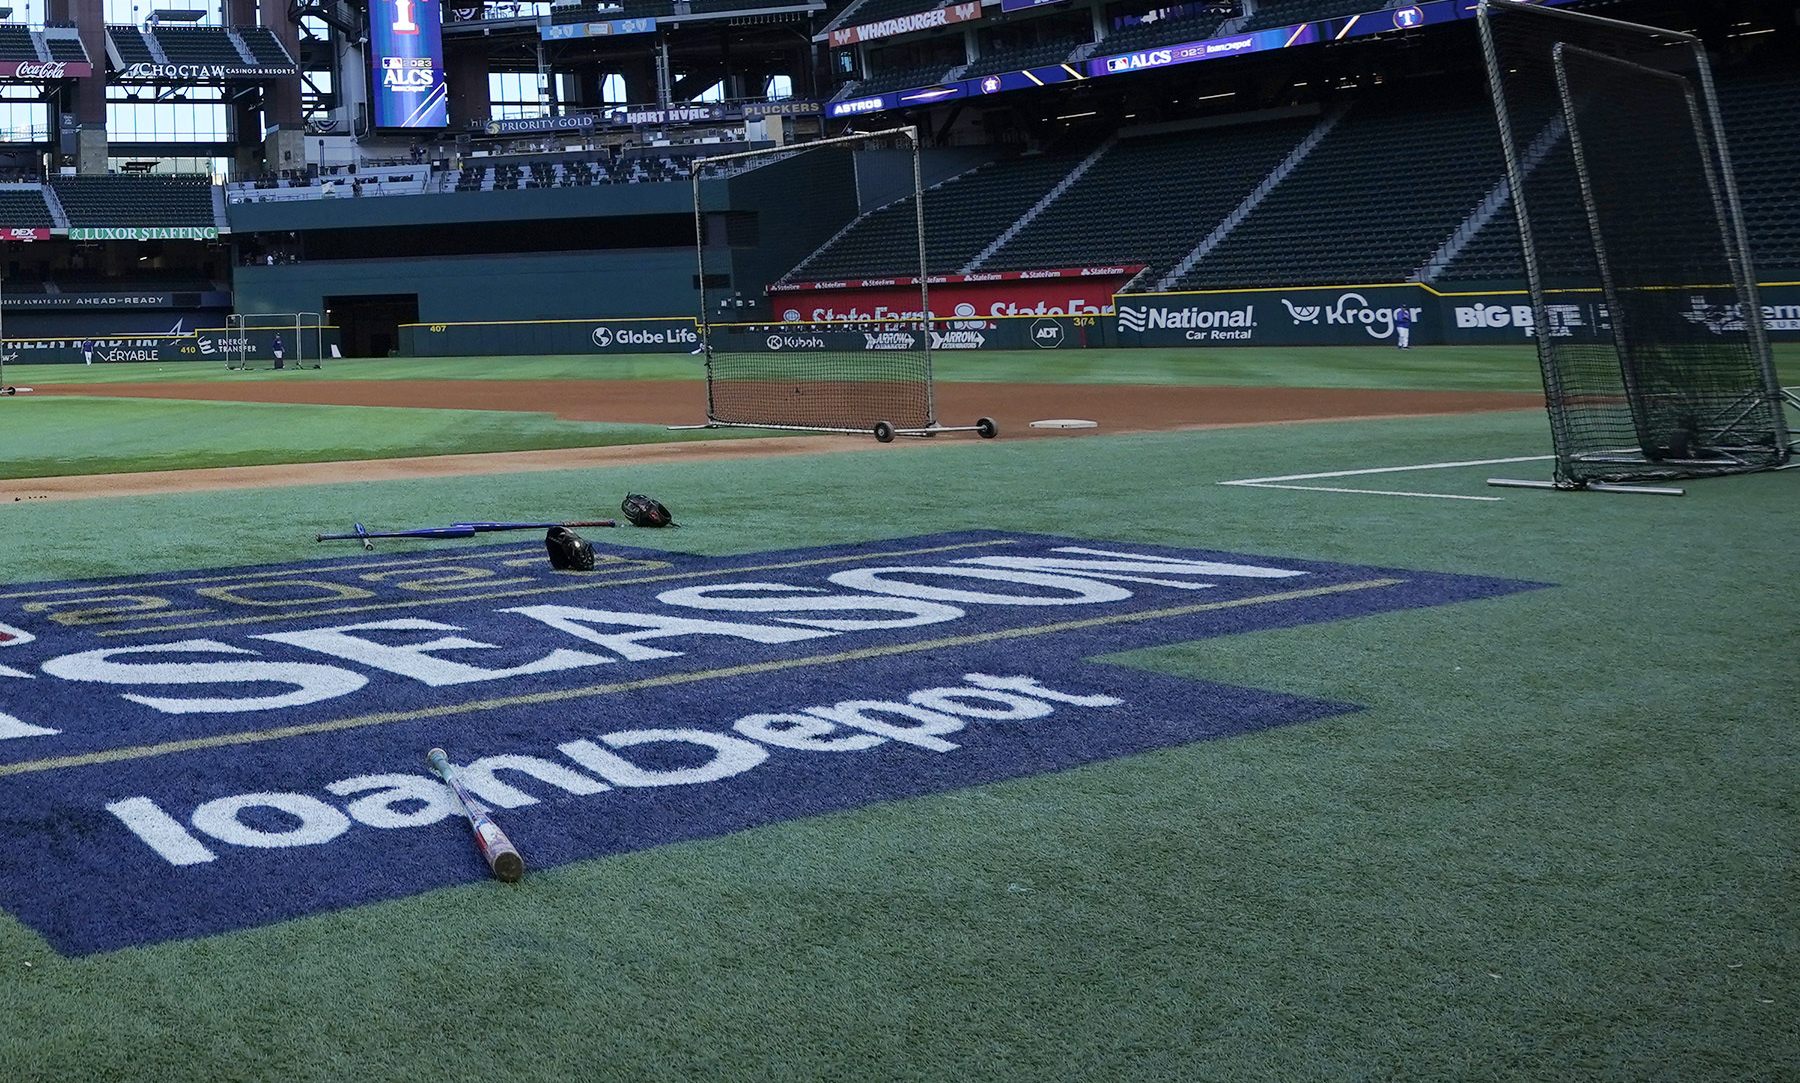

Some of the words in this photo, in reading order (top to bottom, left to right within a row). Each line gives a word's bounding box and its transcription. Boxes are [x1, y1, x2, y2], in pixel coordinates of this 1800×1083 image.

[856, 8, 947, 41] WHATABURGER
[403, 59, 432, 68] 2023
[1129, 49, 1172, 69] ALCS
[1173, 45, 1206, 61] 2023
[139, 62, 225, 78] CHOCTAW
[384, 68, 434, 86] ALCS
[744, 102, 820, 116] PLUCKERS
[833, 97, 883, 116] ASTROS
[627, 110, 665, 124] HART
[669, 108, 710, 121] HVAC
[501, 117, 555, 132] PRIORITY
[558, 116, 594, 129] GOLD
[11, 228, 35, 236] DEX
[84, 228, 139, 240] LUXOR
[141, 227, 216, 240] STAFFING
[125, 296, 164, 304] READY
[1073, 317, 1095, 327] 374
[1148, 304, 1253, 330] National
[1511, 304, 1582, 327] BTE
[430, 324, 447, 333] 407
[1036, 326, 1059, 339] ADT
[1186, 330, 1209, 340] Car
[1211, 329, 1252, 340] Rental
[218, 338, 249, 346] ENERGY
[616, 328, 665, 345] Globe
[668, 328, 698, 345] Life
[784, 336, 824, 348] Kubota
[942, 331, 976, 343] ARROW
[218, 344, 257, 353] TRANSFER
[103, 670, 1124, 867] loanDepot
